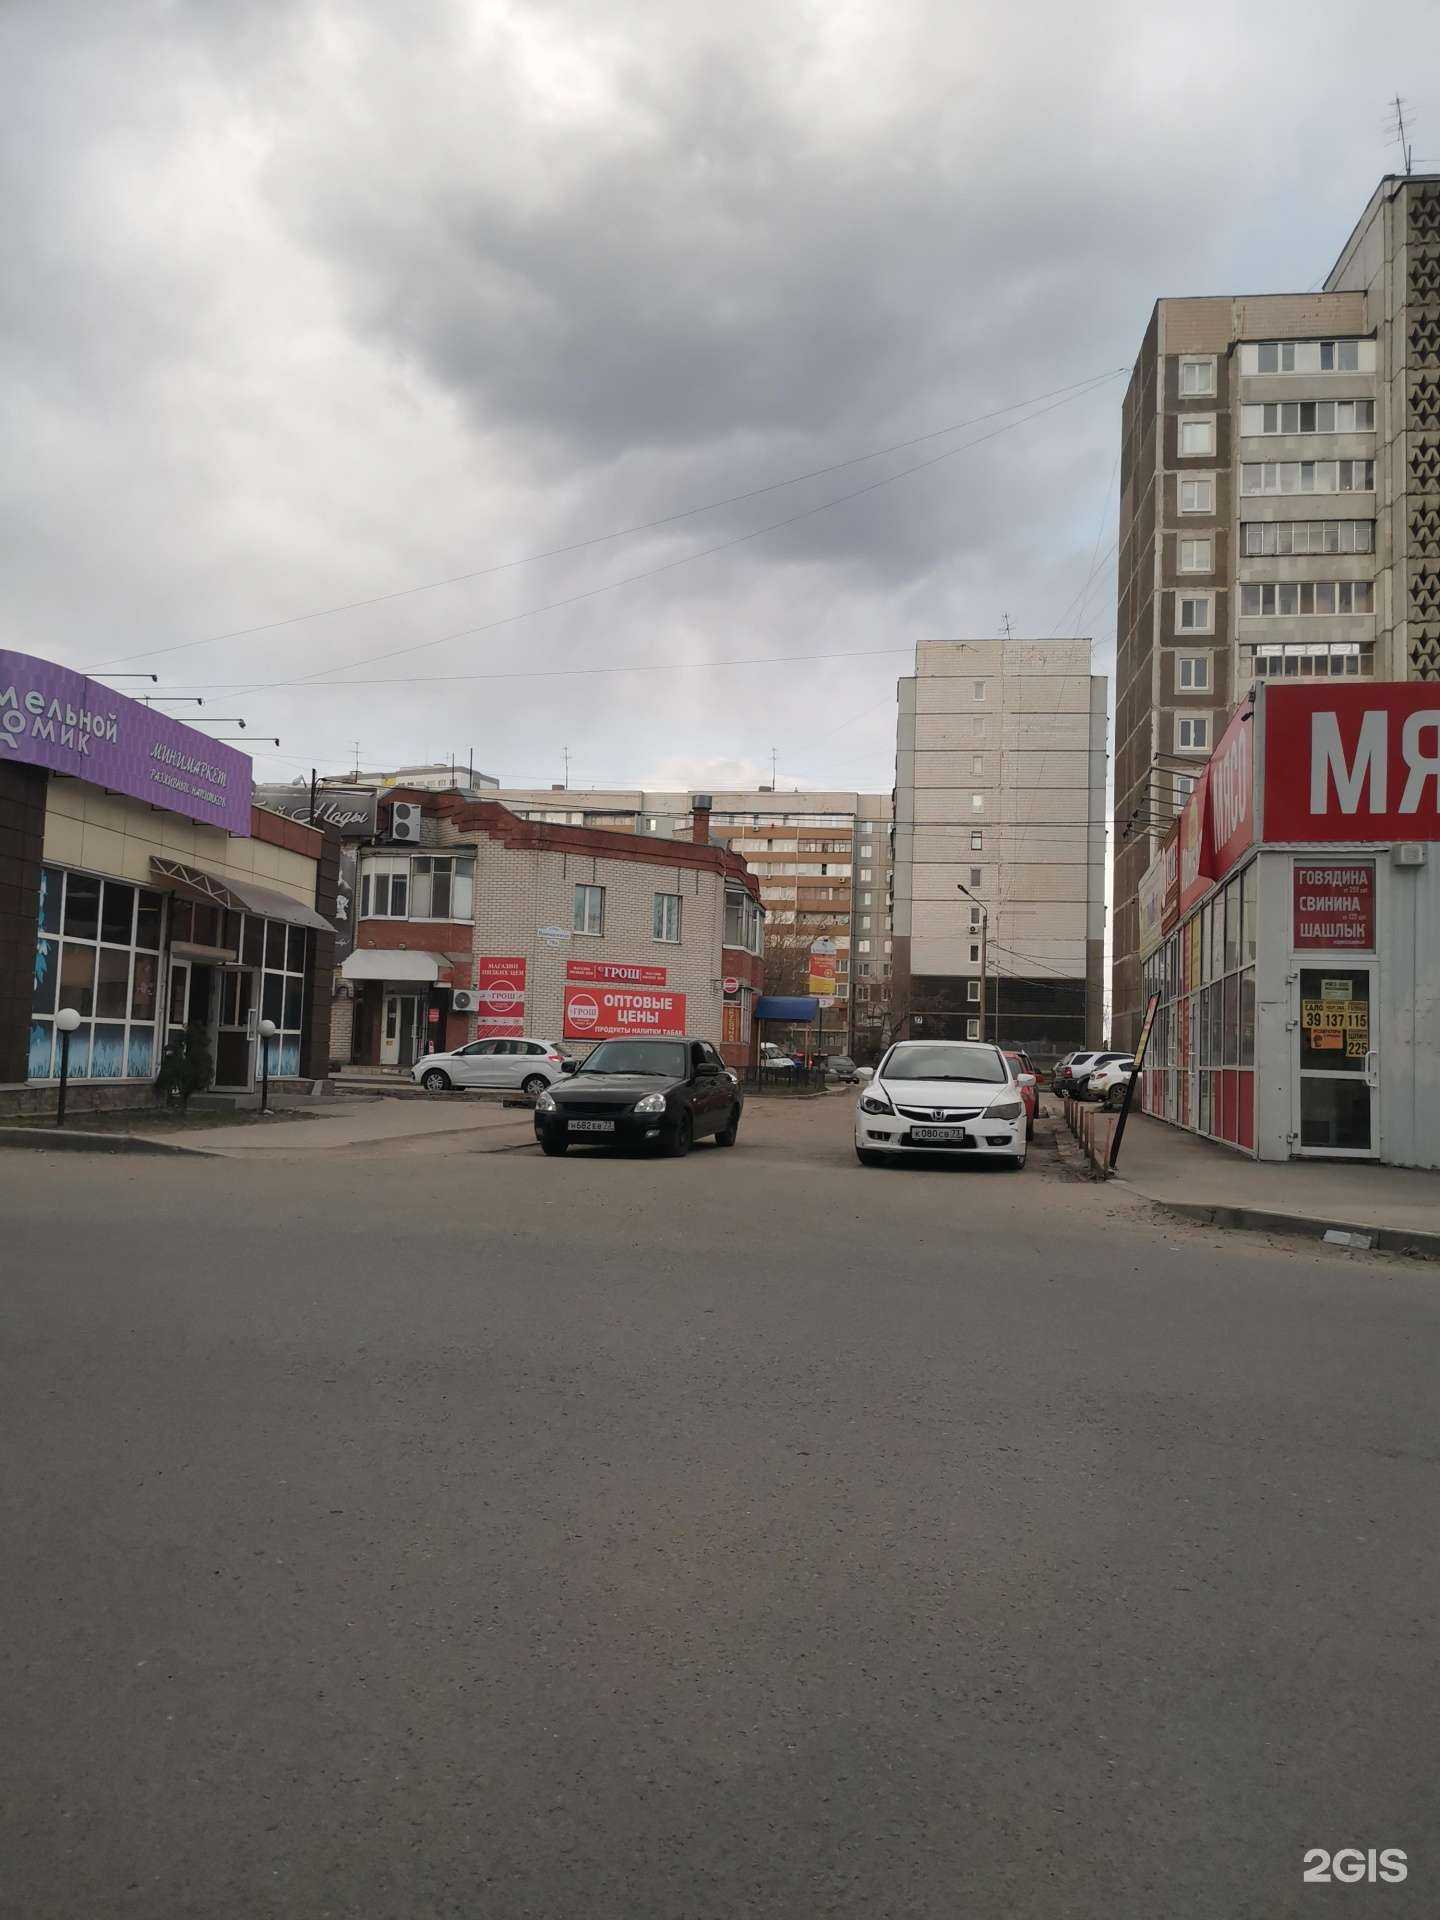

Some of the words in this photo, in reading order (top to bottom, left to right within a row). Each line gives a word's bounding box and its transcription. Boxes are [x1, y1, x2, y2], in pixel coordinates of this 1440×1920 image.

[1299, 870, 1368, 887] ГОВЯДИНА
[1299, 896, 1361, 912] СВИНИНА
[1300, 923, 1366, 938] ШАШЛЫК
[603, 966, 641, 980] ГРОШ
[491, 992, 515, 1000] ГРОШ
[603, 993, 673, 1010] ОПТОВЫЕ
[617, 1009, 659, 1024] ЦЕНЫ
[1306, 1013, 1321, 1027] 39
[1325, 1014, 1344, 1027] 137
[1348, 1014, 1367, 1027] 115
[594, 1025, 631, 1035] ПРОДУКТЫ
[1348, 1042, 1367, 1055] 225
